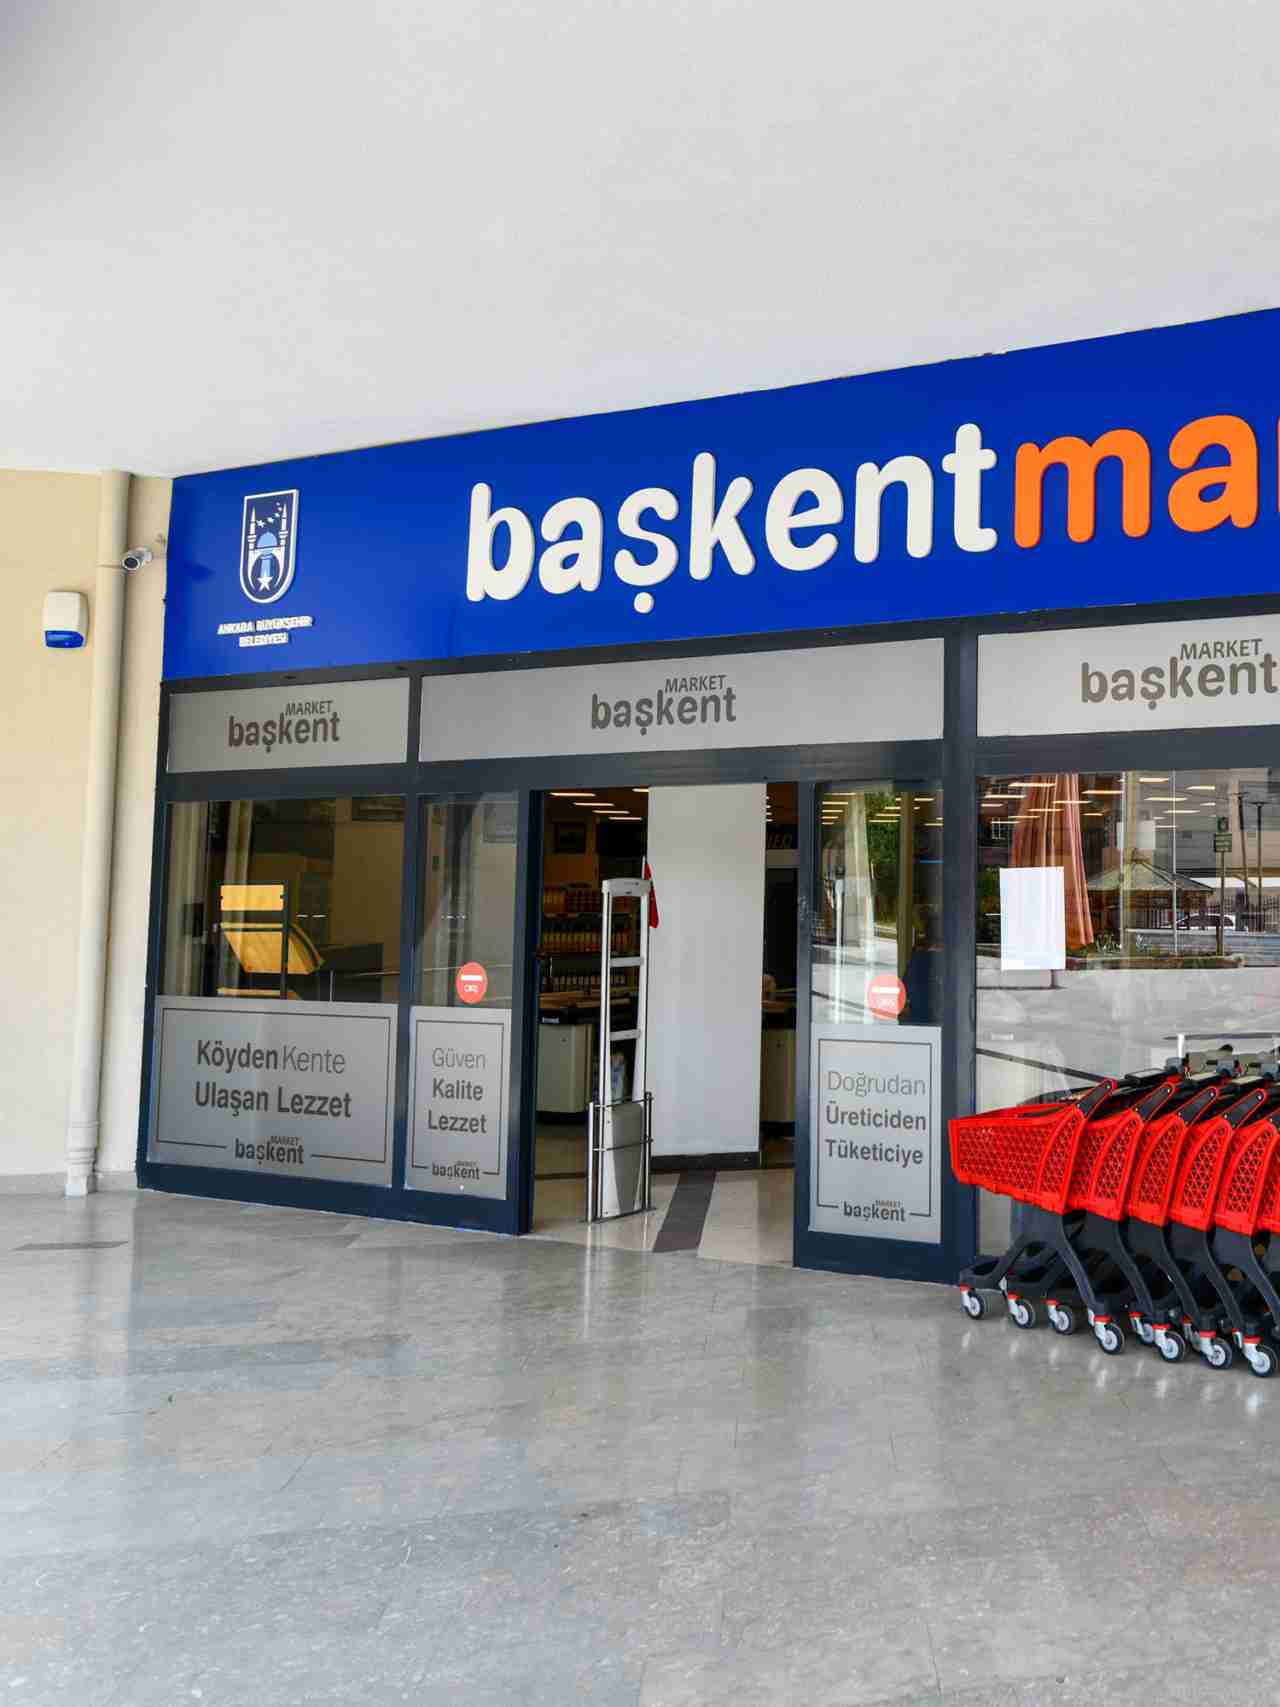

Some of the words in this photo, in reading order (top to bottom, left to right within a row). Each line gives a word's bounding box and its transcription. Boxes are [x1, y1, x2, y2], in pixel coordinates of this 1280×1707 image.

[1179, 638, 1263, 660] MARKET
[665, 675, 726, 693] MARKET
[1080, 652, 1279, 711] başkent
[285, 700, 332, 716] MARKET
[590, 686, 737, 735] başkent
[227, 711, 340, 754] başkent
[197, 1039, 278, 1075] Köyden
[282, 1044, 346, 1075] Kente
[431, 1047, 486, 1070] Güven
[432, 1078, 484, 1102] Kalite
[827, 1070, 926, 1098] Doğrudan
[195, 1081, 269, 1117] Ulaşan
[277, 1085, 352, 1119] Lezzet
[428, 1110, 487, 1134] Lezzet
[826, 1101, 927, 1131] Üreticiden
[235, 1138, 304, 1166] başkent
[825, 1139, 923, 1168] Tüketiciye
[843, 1201, 905, 1222] başkent
